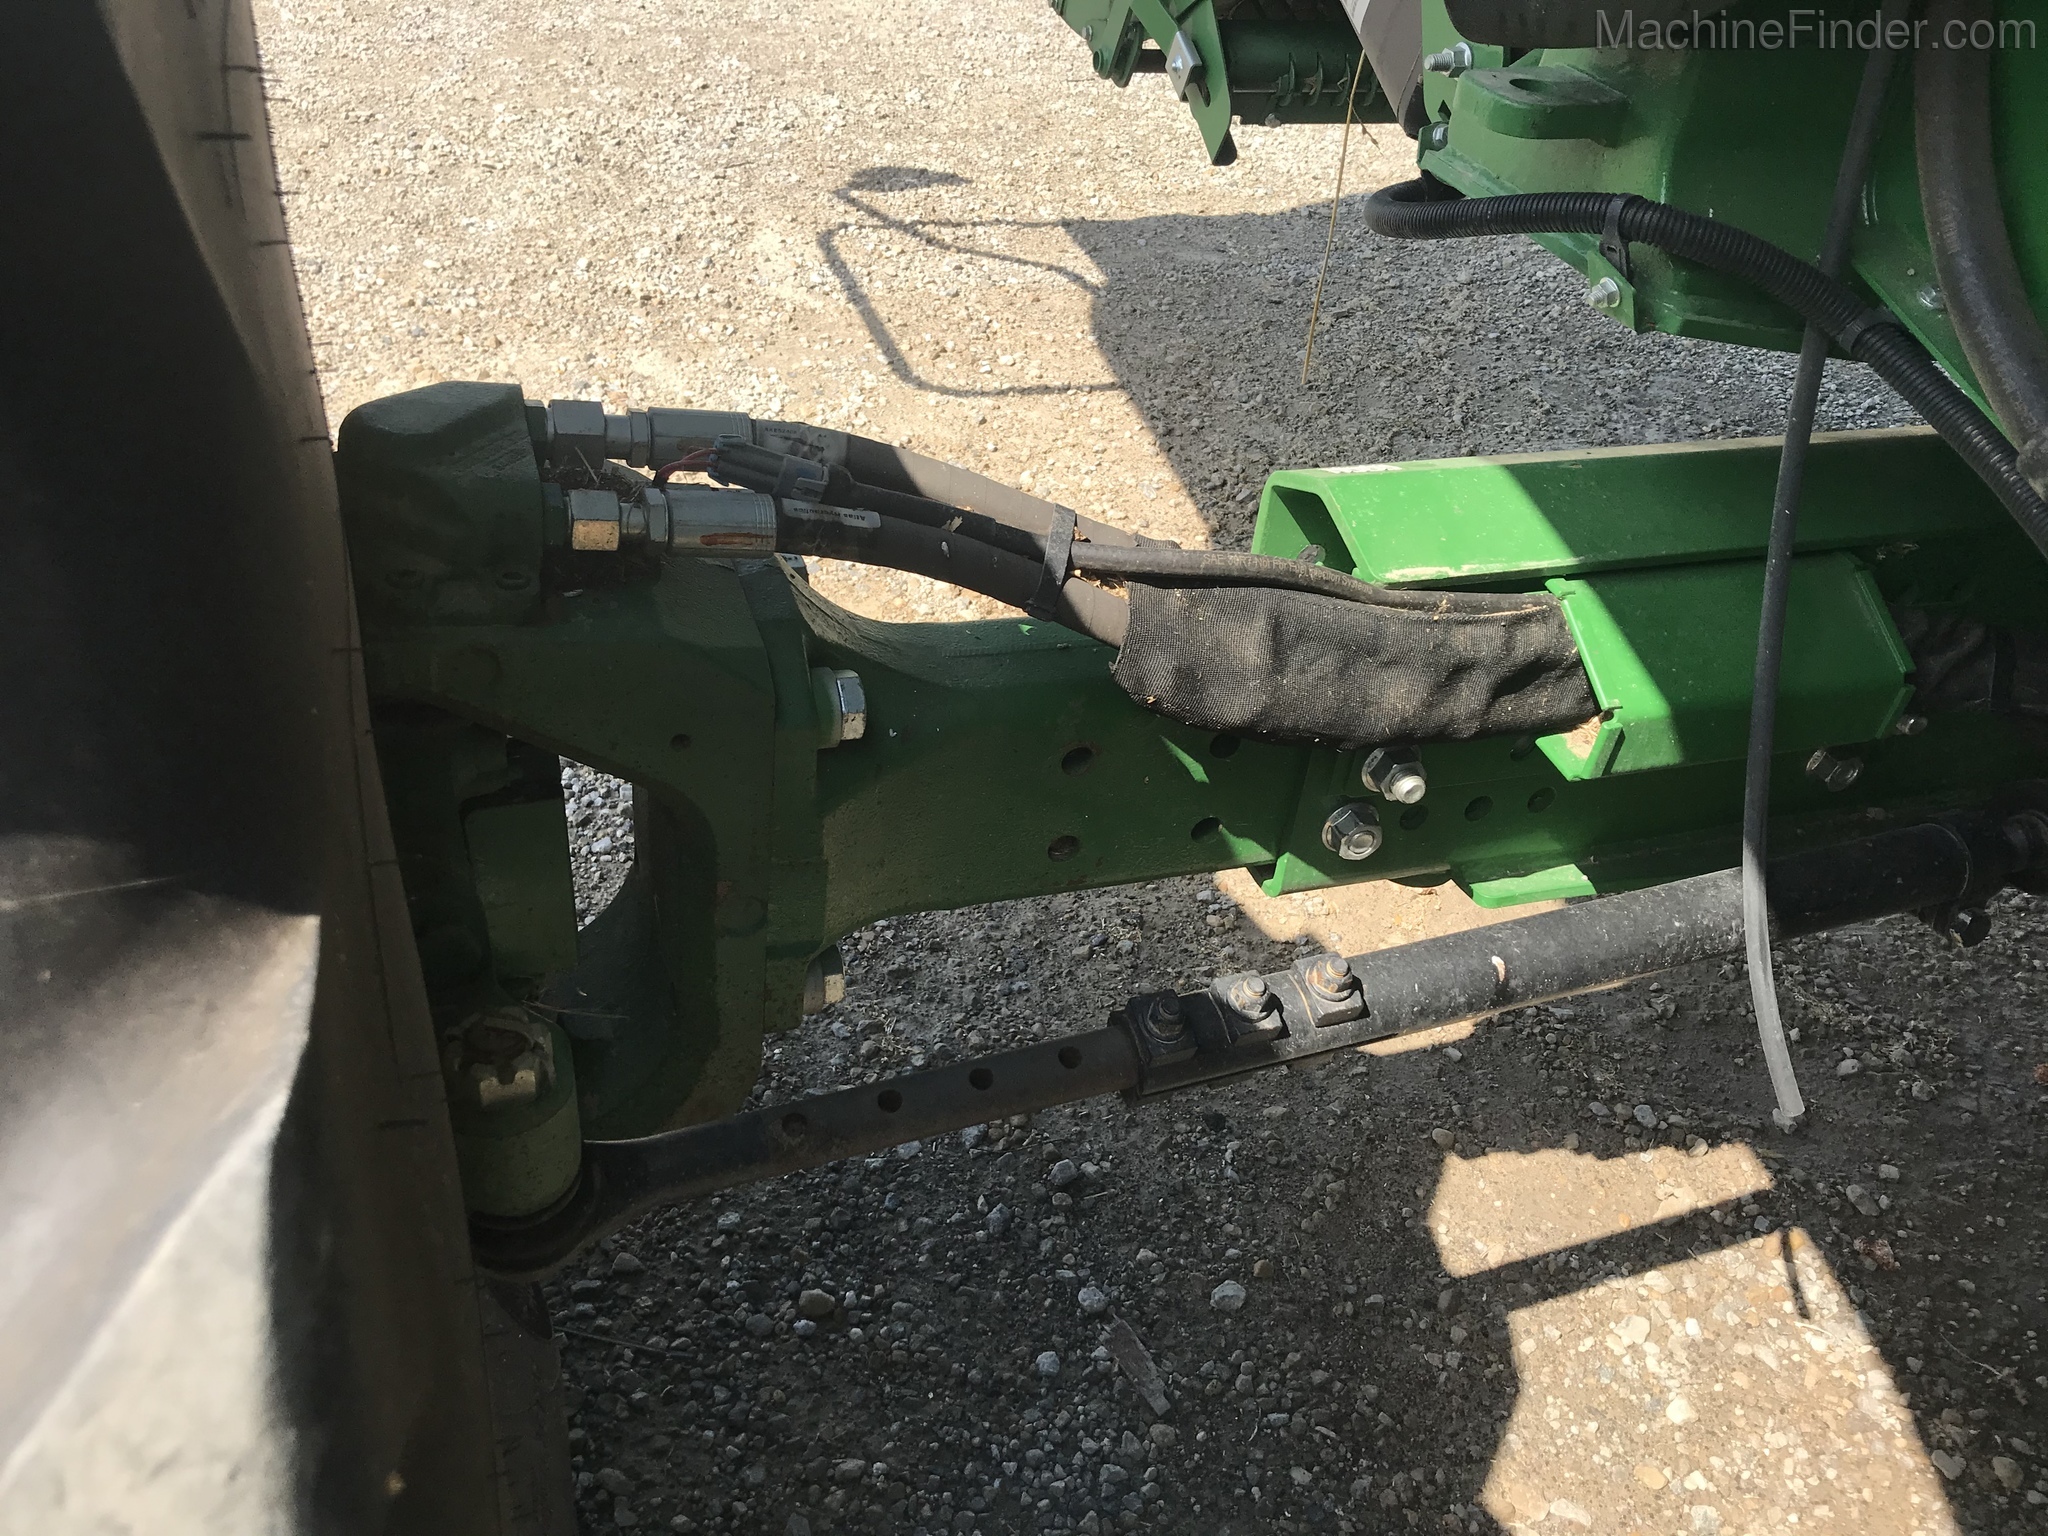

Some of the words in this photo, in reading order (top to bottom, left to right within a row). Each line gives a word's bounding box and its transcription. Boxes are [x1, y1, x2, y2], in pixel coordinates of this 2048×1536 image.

[843, 513, 866, 521] Atlas
[1203, 553, 1225, 566] SAE
[1272, 557, 1288, 571] For
[1341, 575, 1373, 594] Systems
